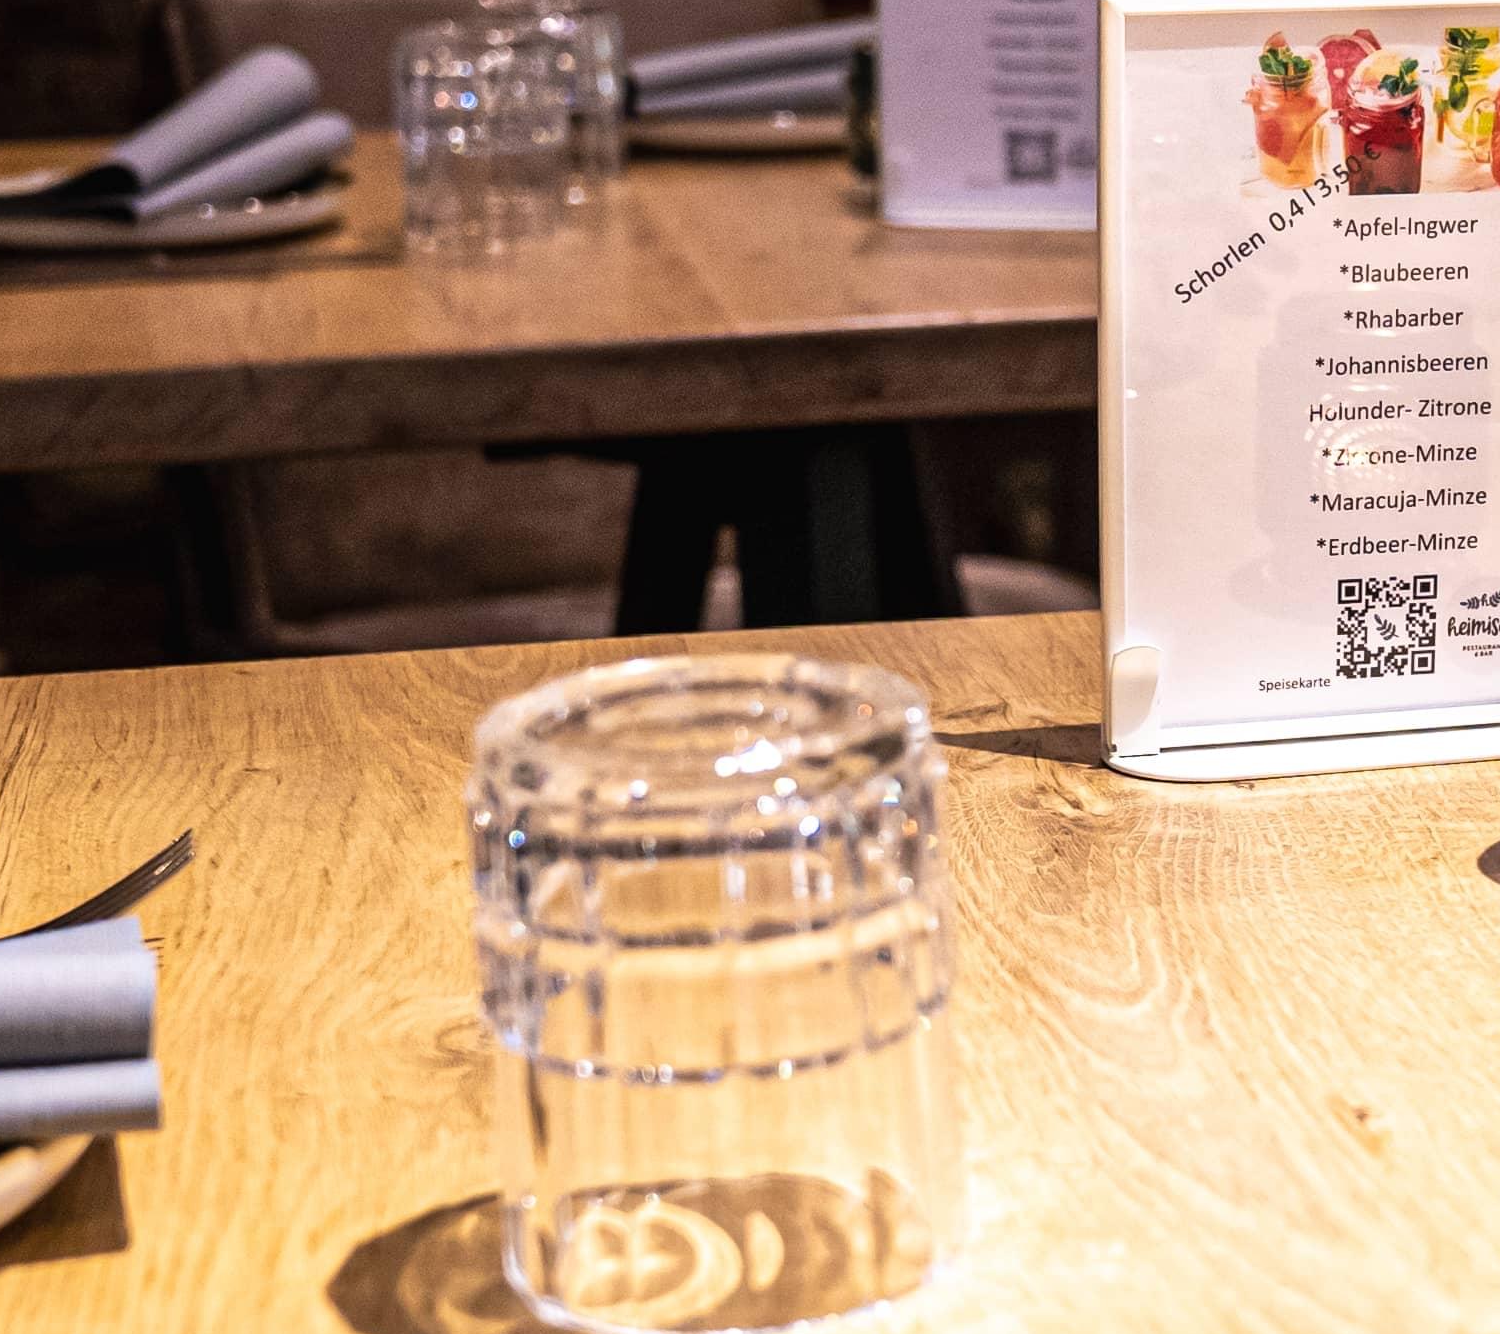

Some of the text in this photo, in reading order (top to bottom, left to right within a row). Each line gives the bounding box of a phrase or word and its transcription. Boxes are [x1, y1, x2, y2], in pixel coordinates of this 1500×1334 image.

[1174, 231, 1266, 304] Schorlen
[1268, 198, 1305, 232] 0,4
[1313, 154, 1362, 199] 3,50
[1363, 140, 1381, 161] €
[1309, 398, 1493, 422] Holunder- Zitrone
[1321, 443, 1478, 467] Zone-Minze
[1258, 676, 1332, 693] Speisekarte
